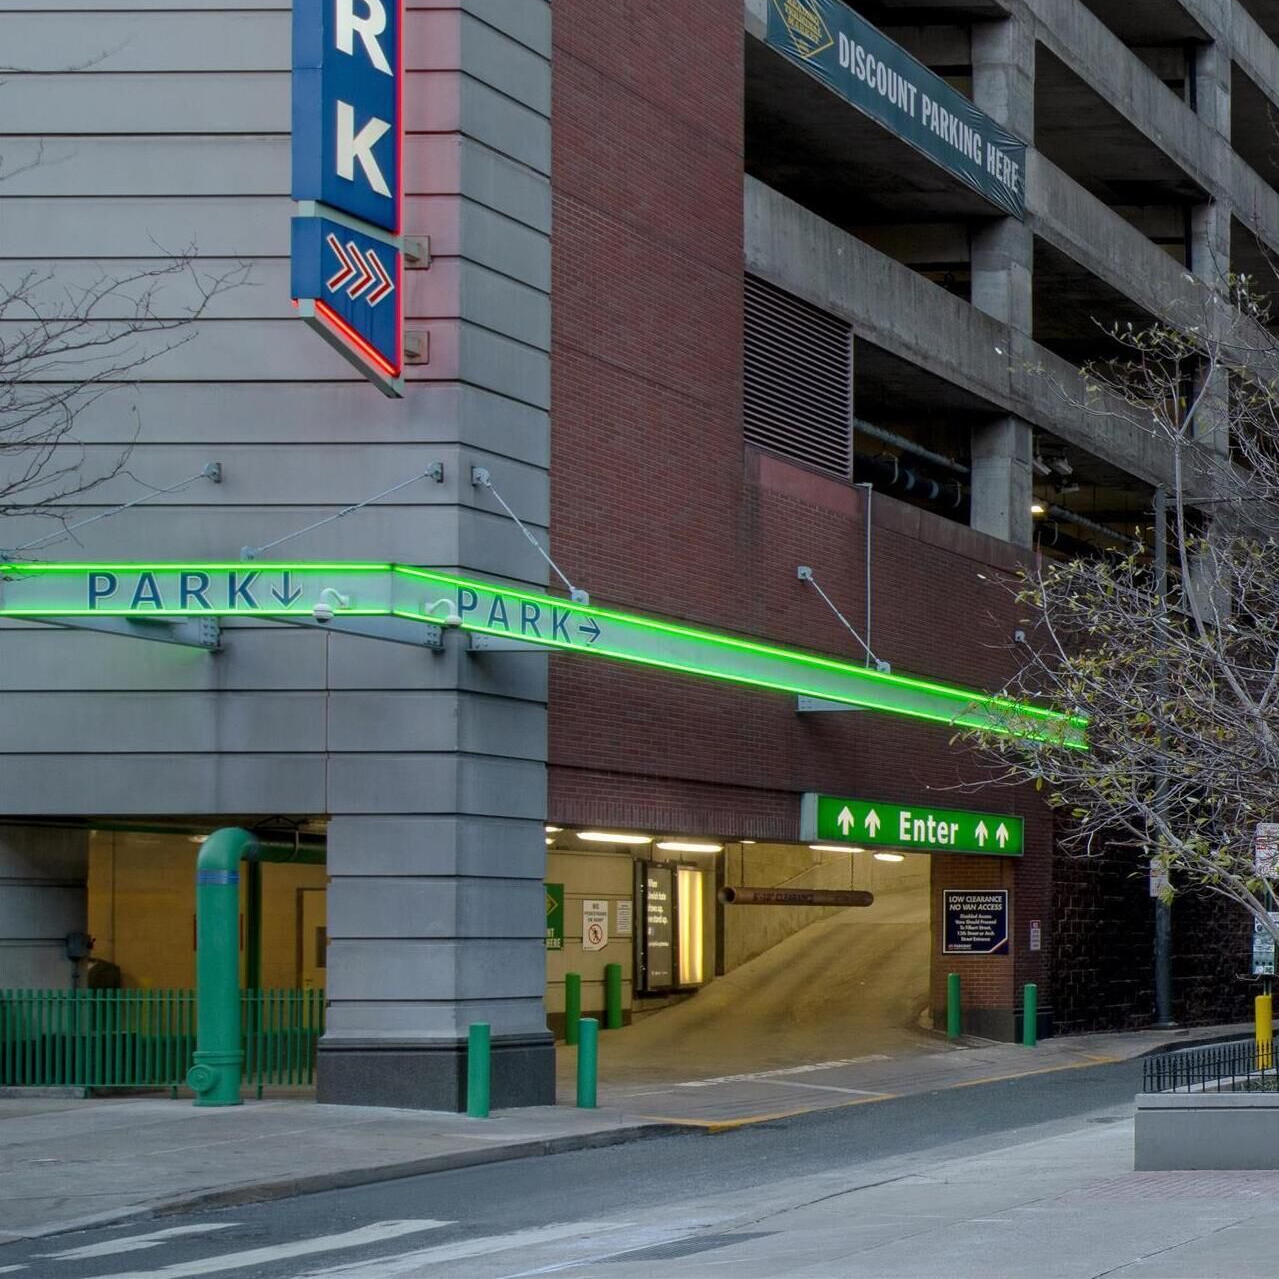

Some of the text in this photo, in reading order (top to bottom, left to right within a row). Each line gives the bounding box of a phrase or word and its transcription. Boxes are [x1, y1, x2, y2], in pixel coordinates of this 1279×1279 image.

[838, 31, 1019, 193] DISCOUNT PARKING HERE
[87, 570, 264, 610] PARK
[457, 585, 574, 643] PARK
[899, 810, 959, 845] Enter
